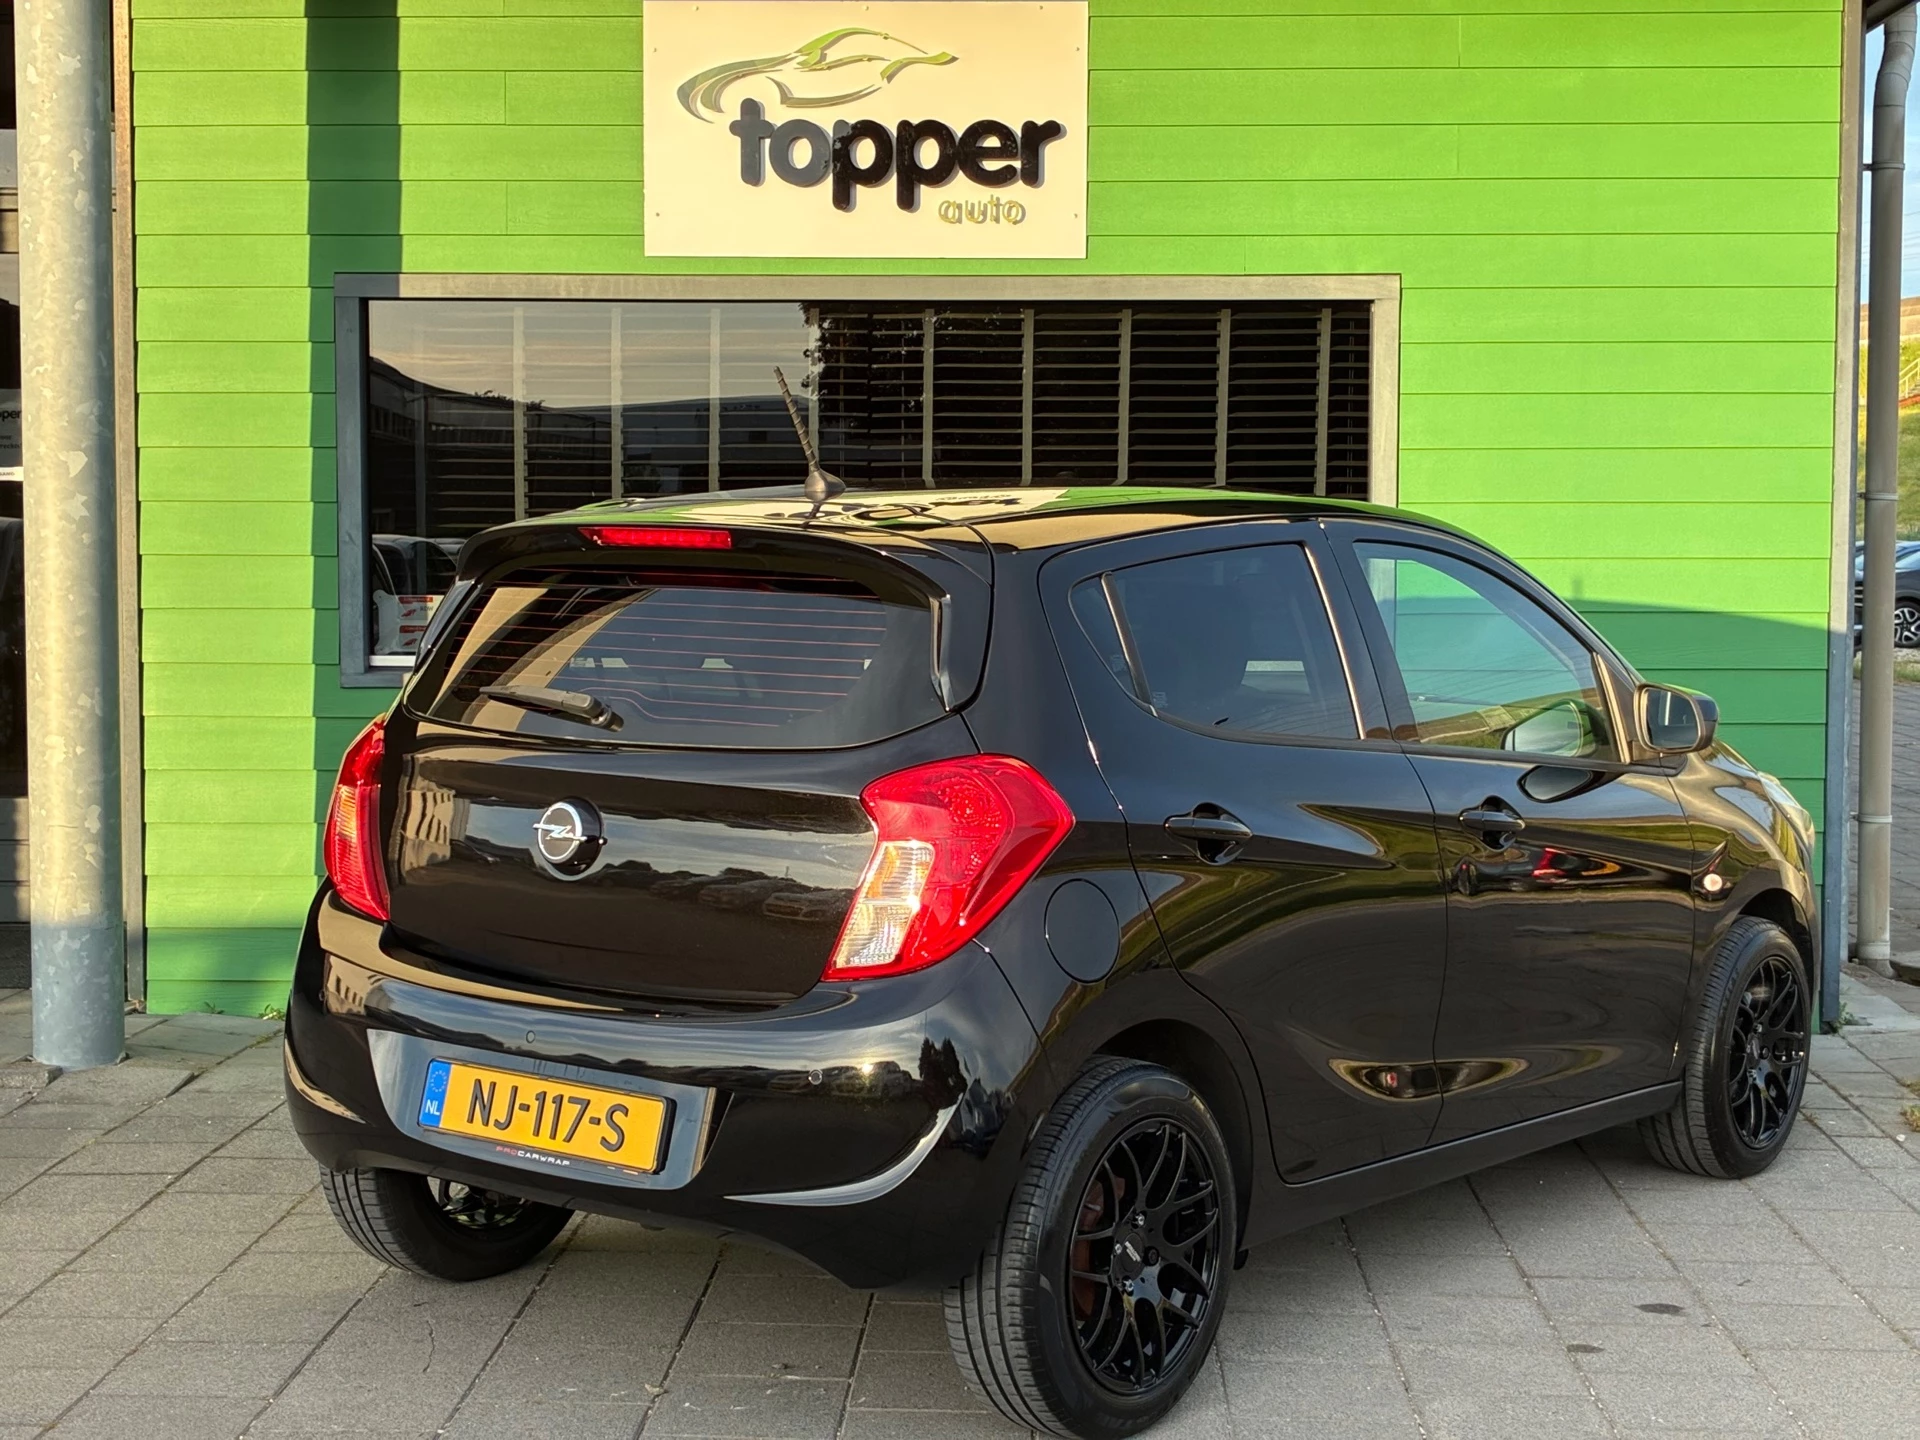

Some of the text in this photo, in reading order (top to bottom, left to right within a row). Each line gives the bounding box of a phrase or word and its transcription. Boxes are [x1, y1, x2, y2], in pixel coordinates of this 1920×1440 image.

[729, 98, 1063, 210] topper
[938, 194, 1024, 223] auto
[425, 1098, 441, 1116] NL
[466, 1078, 629, 1152] NJ-117-S
[495, 1145, 571, 1166] PROCARWRAP
